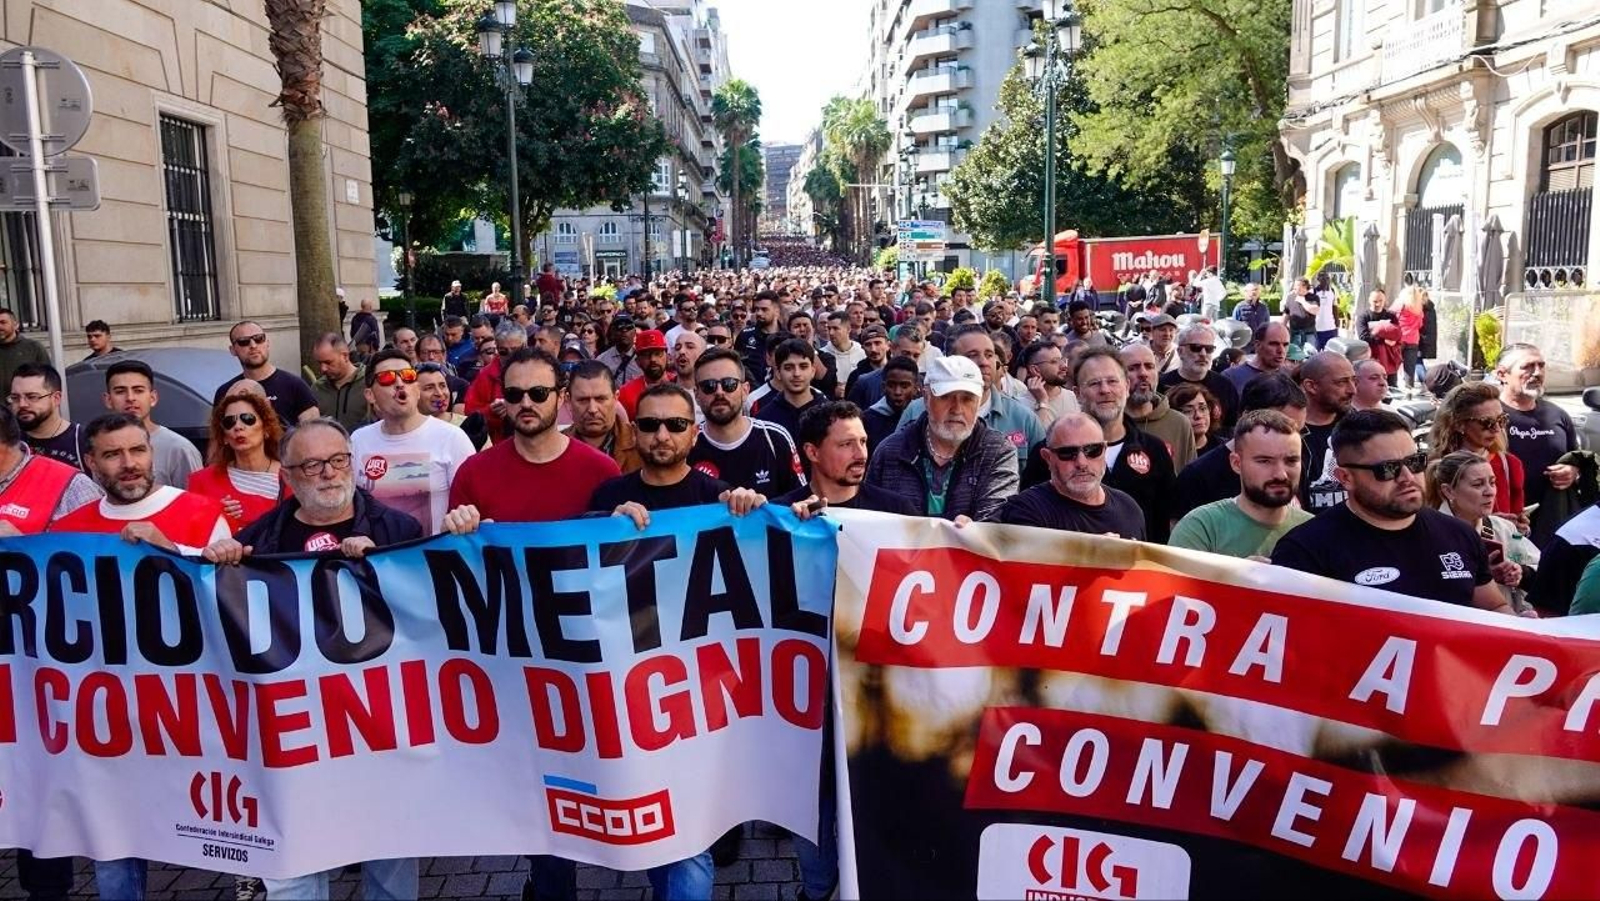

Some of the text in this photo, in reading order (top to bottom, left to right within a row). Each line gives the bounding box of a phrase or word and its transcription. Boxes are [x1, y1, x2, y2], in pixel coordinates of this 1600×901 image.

[1111, 250, 1185, 270] Mahou
[1365, 569, 1390, 583] Ford
[1441, 570, 1473, 580] SIERRA
[215, 560, 395, 674] DO
[424, 525, 828, 663] METAL
[888, 570, 1289, 684] CONTRA
[1348, 635, 1417, 715] A
[34, 658, 500, 768] CONVENIO
[523, 637, 827, 759] DIGNO
[190, 771, 258, 828] CIG
[555, 798, 663, 837] CCOO
[994, 722, 1559, 901] CONVENIO
[175, 823, 217, 837] Confederación
[218, 829, 253, 842] Intersindical
[202, 843, 248, 862] SERVIZOS
[1027, 834, 1138, 899] CIG
